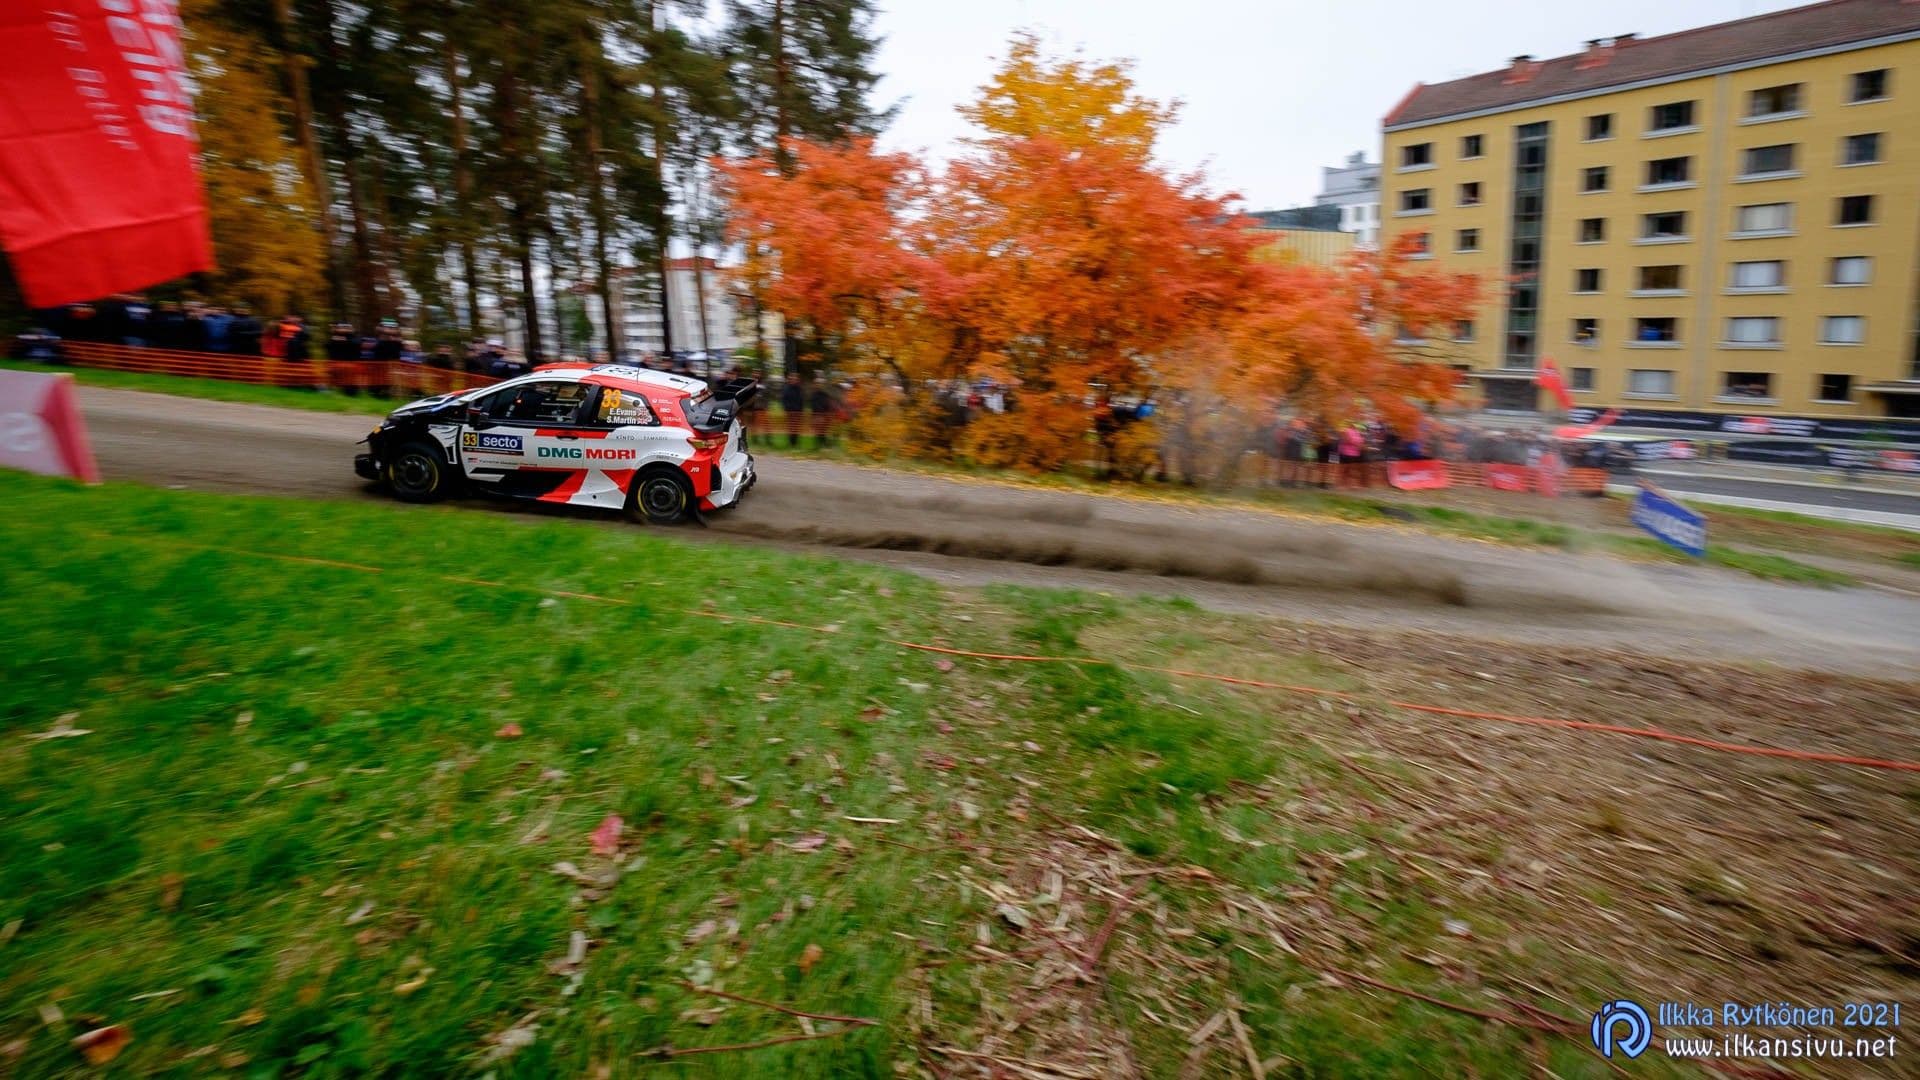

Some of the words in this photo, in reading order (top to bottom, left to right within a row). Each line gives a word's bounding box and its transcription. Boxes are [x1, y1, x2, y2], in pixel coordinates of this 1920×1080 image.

[601, 388, 622, 408] 33
[609, 408, 637, 416] E.Evans
[606, 416, 637, 425] S.Martin
[463, 433, 477, 446] 33
[482, 436, 518, 448] secto
[537, 446, 582, 459] DMG
[585, 448, 636, 460] MORI
